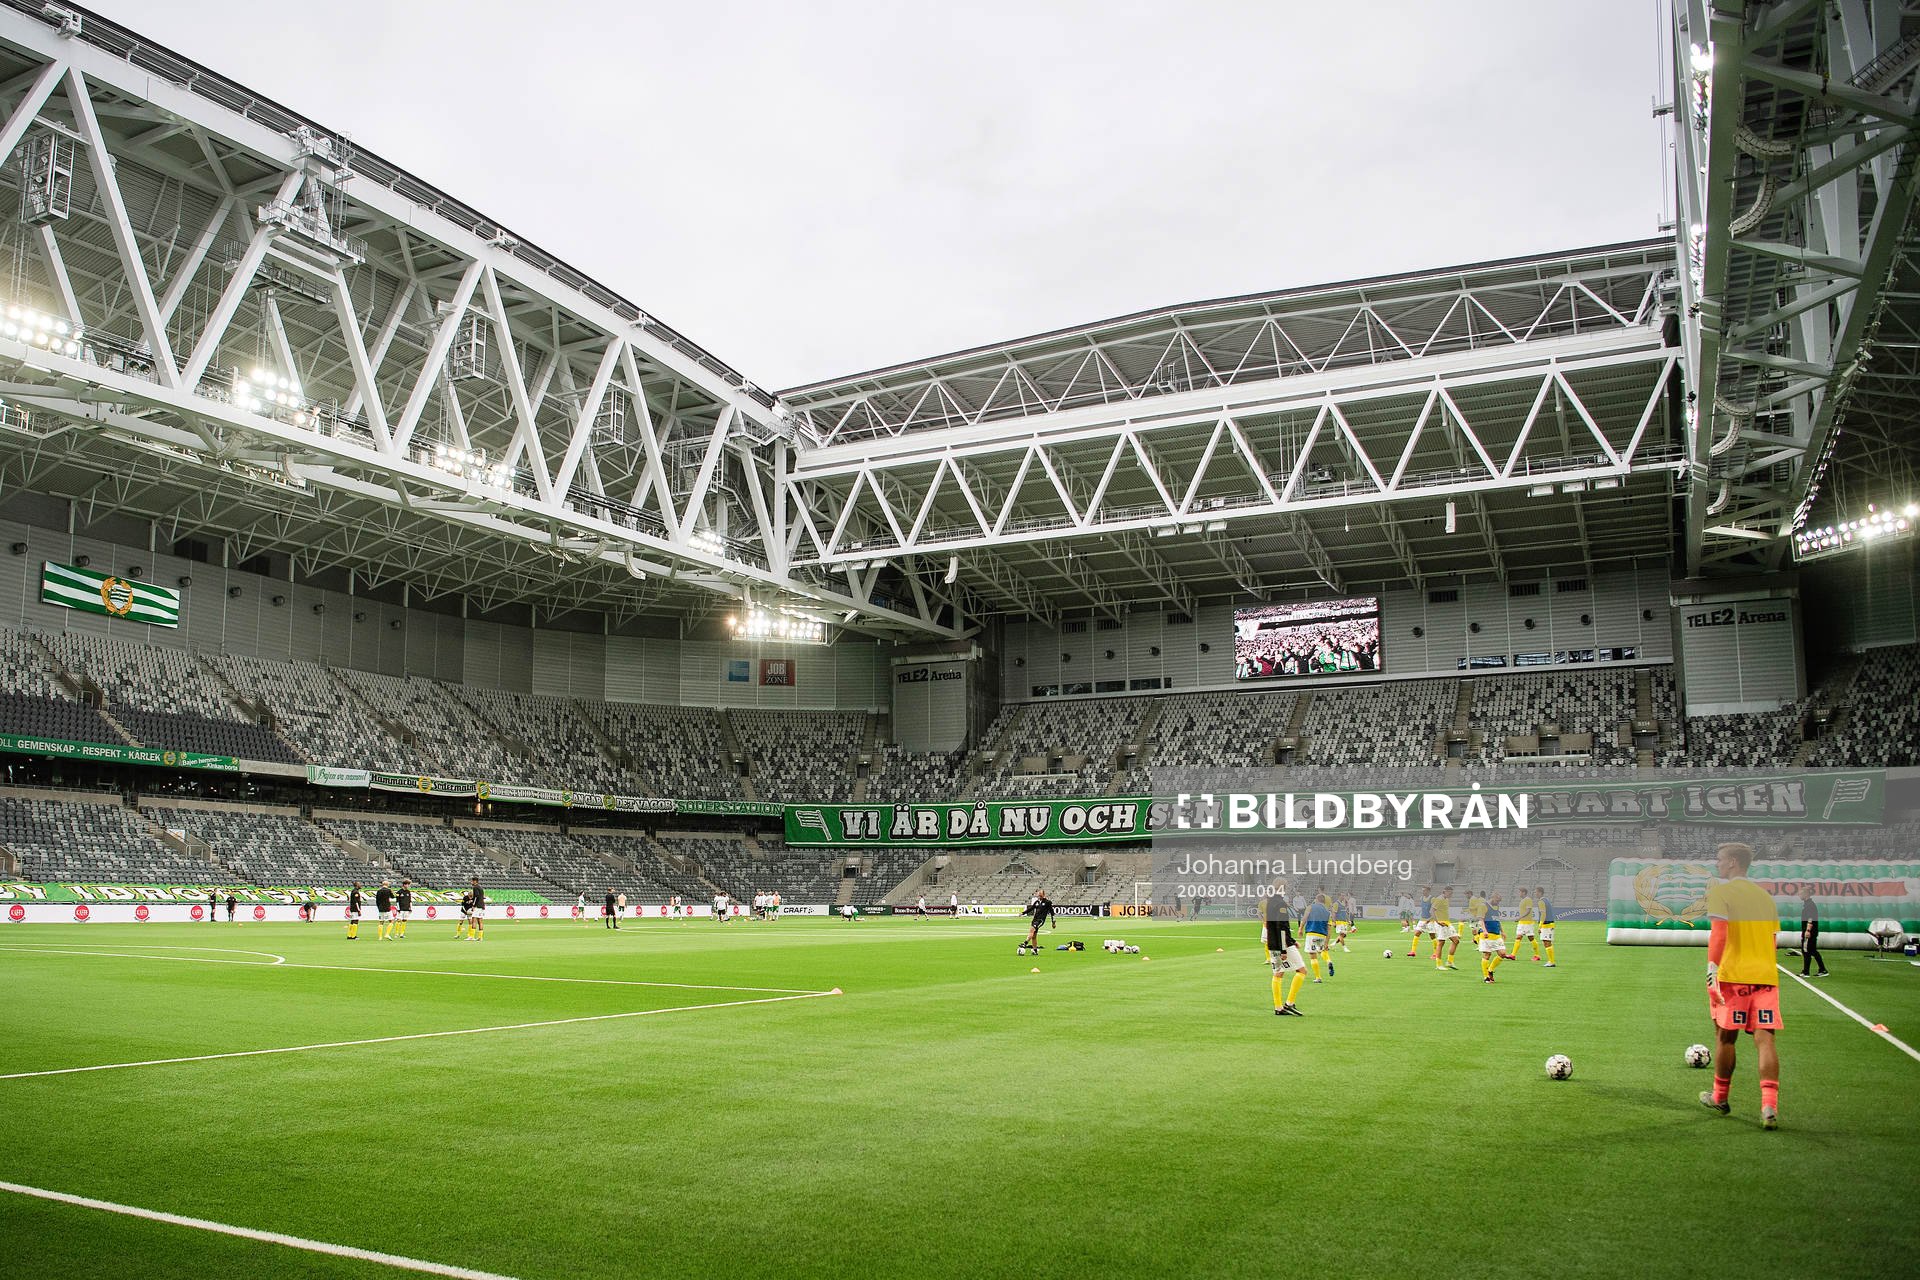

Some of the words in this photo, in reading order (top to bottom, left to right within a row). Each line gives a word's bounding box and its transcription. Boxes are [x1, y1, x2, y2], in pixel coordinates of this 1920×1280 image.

[1687, 608, 1735, 627] TELE2
[1738, 611, 1786, 624] Arena
[767, 663, 784, 674] JOB
[897, 668, 928, 683] TELE2
[930, 671, 962, 681] Arena
[18, 740, 75, 754] GEMENSKAP
[82, 746, 122, 759] RESPEKT
[128, 749, 161, 762] KÄRLEK
[616, 797, 635, 809] DET
[840, 810, 880, 839] VI
[890, 803, 940, 840] ÄR
[947, 800, 991, 838] DÅ
[999, 806, 1052, 837] NU
[1060, 805, 1138, 834] OCH
[1144, 799, 1223, 831] SEN
[1682, 780, 1808, 817] IGEN
[1767, 882, 1874, 896] JOBMAN
